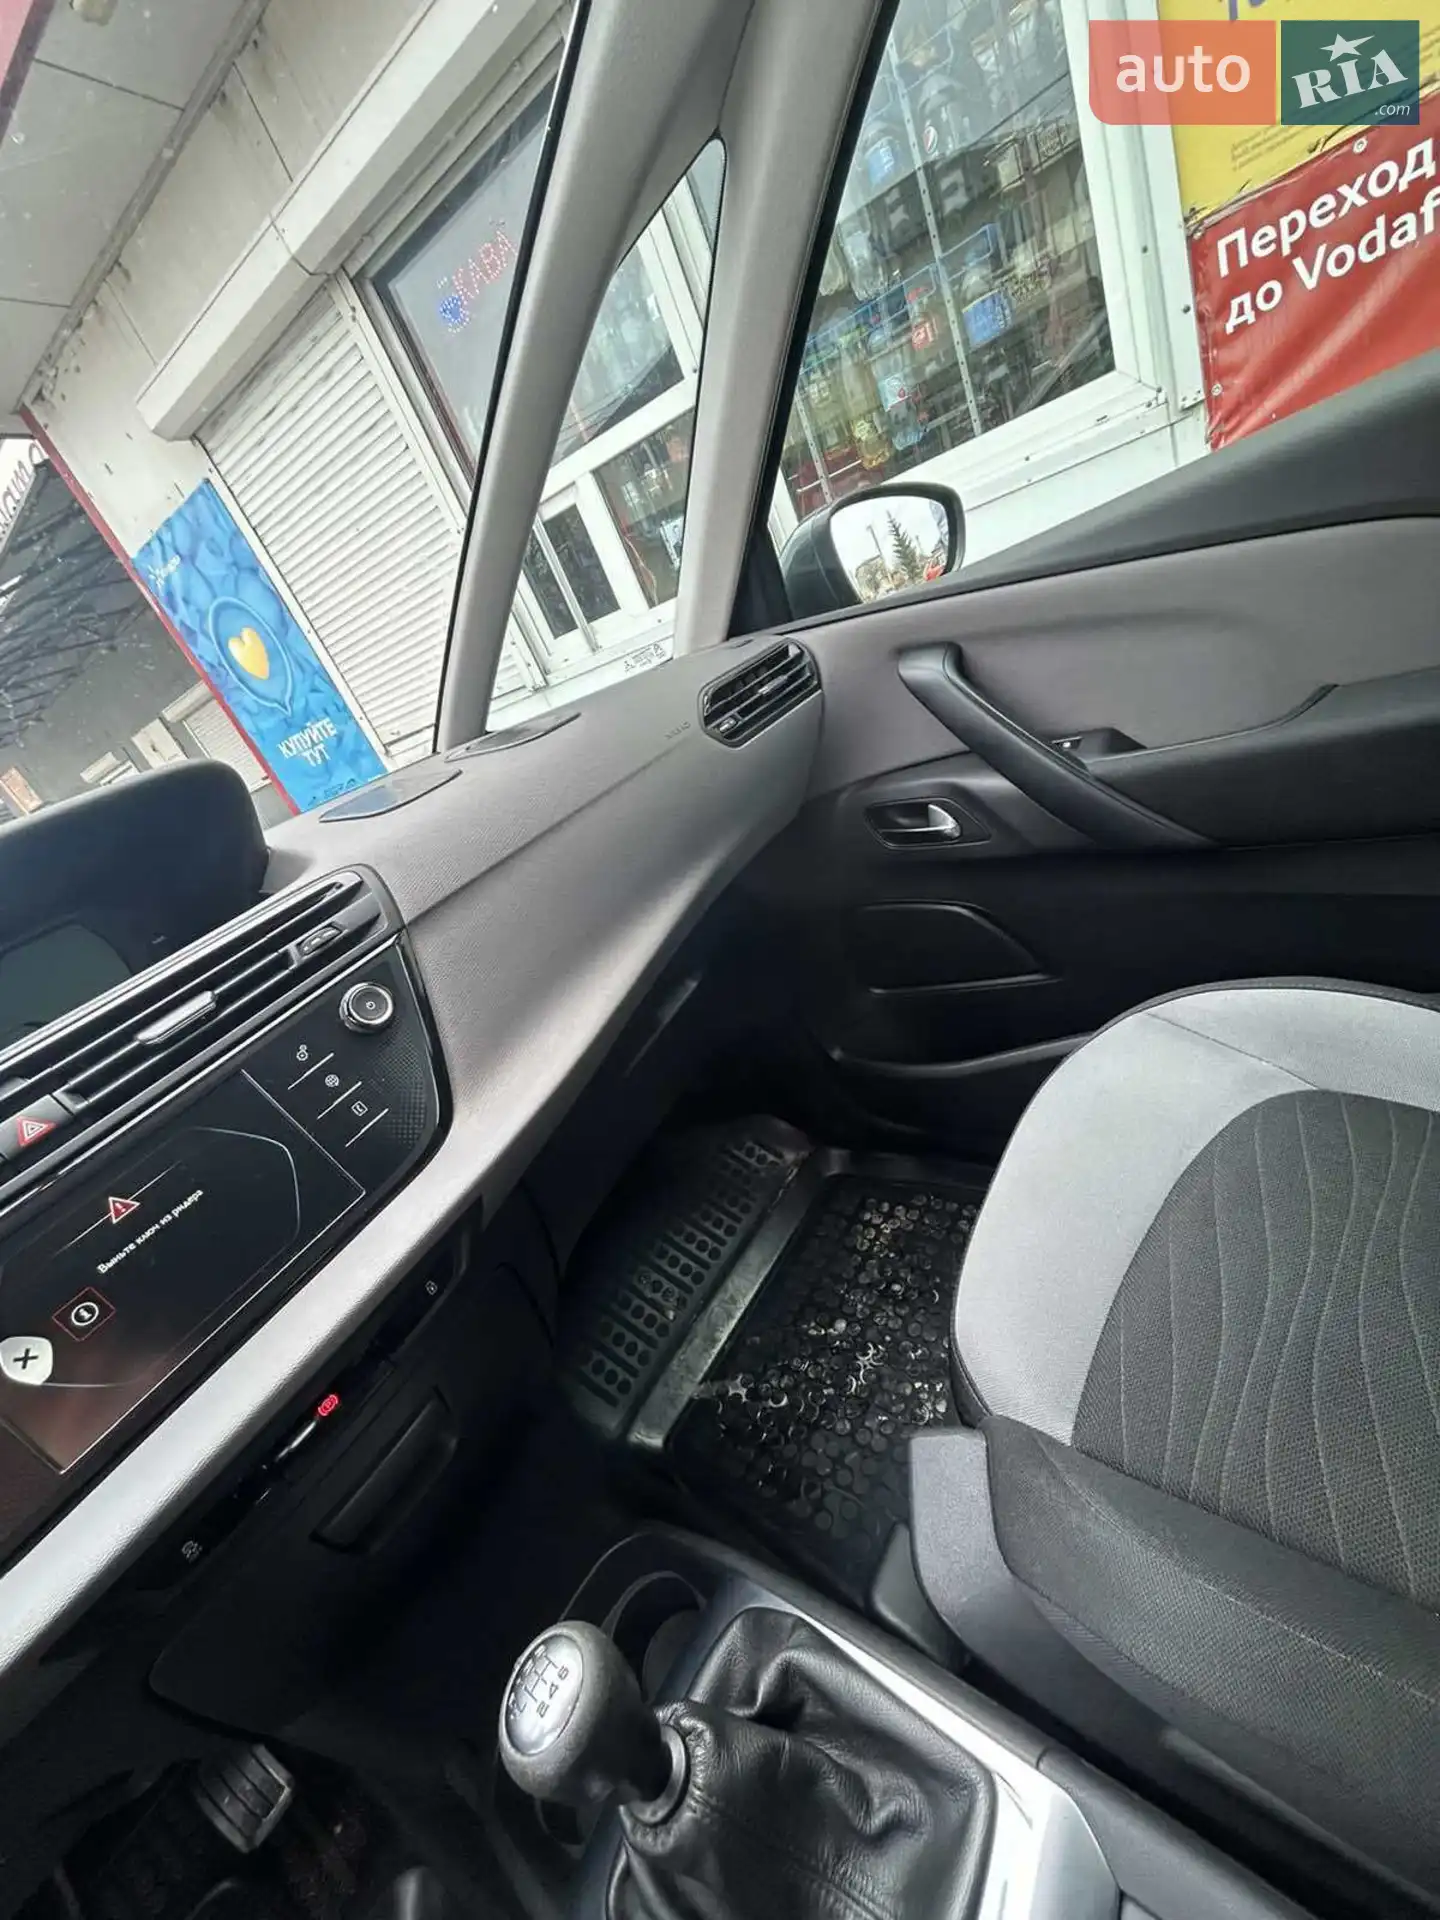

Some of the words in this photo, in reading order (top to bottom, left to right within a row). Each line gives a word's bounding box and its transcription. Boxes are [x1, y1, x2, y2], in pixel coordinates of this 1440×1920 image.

[1216, 137, 1437, 279] Переход
[452, 229, 519, 306] КАВА
[1225, 279, 1283, 335] до
[277, 716, 338, 759] КУПУЙТЕ
[302, 743, 332, 767] ТУТ
[97, 1243, 137, 1274] Выньте
[135, 1223, 161, 1245] ключ
[159, 1214, 173, 1226] из
[171, 1189, 204, 1218] ридера
